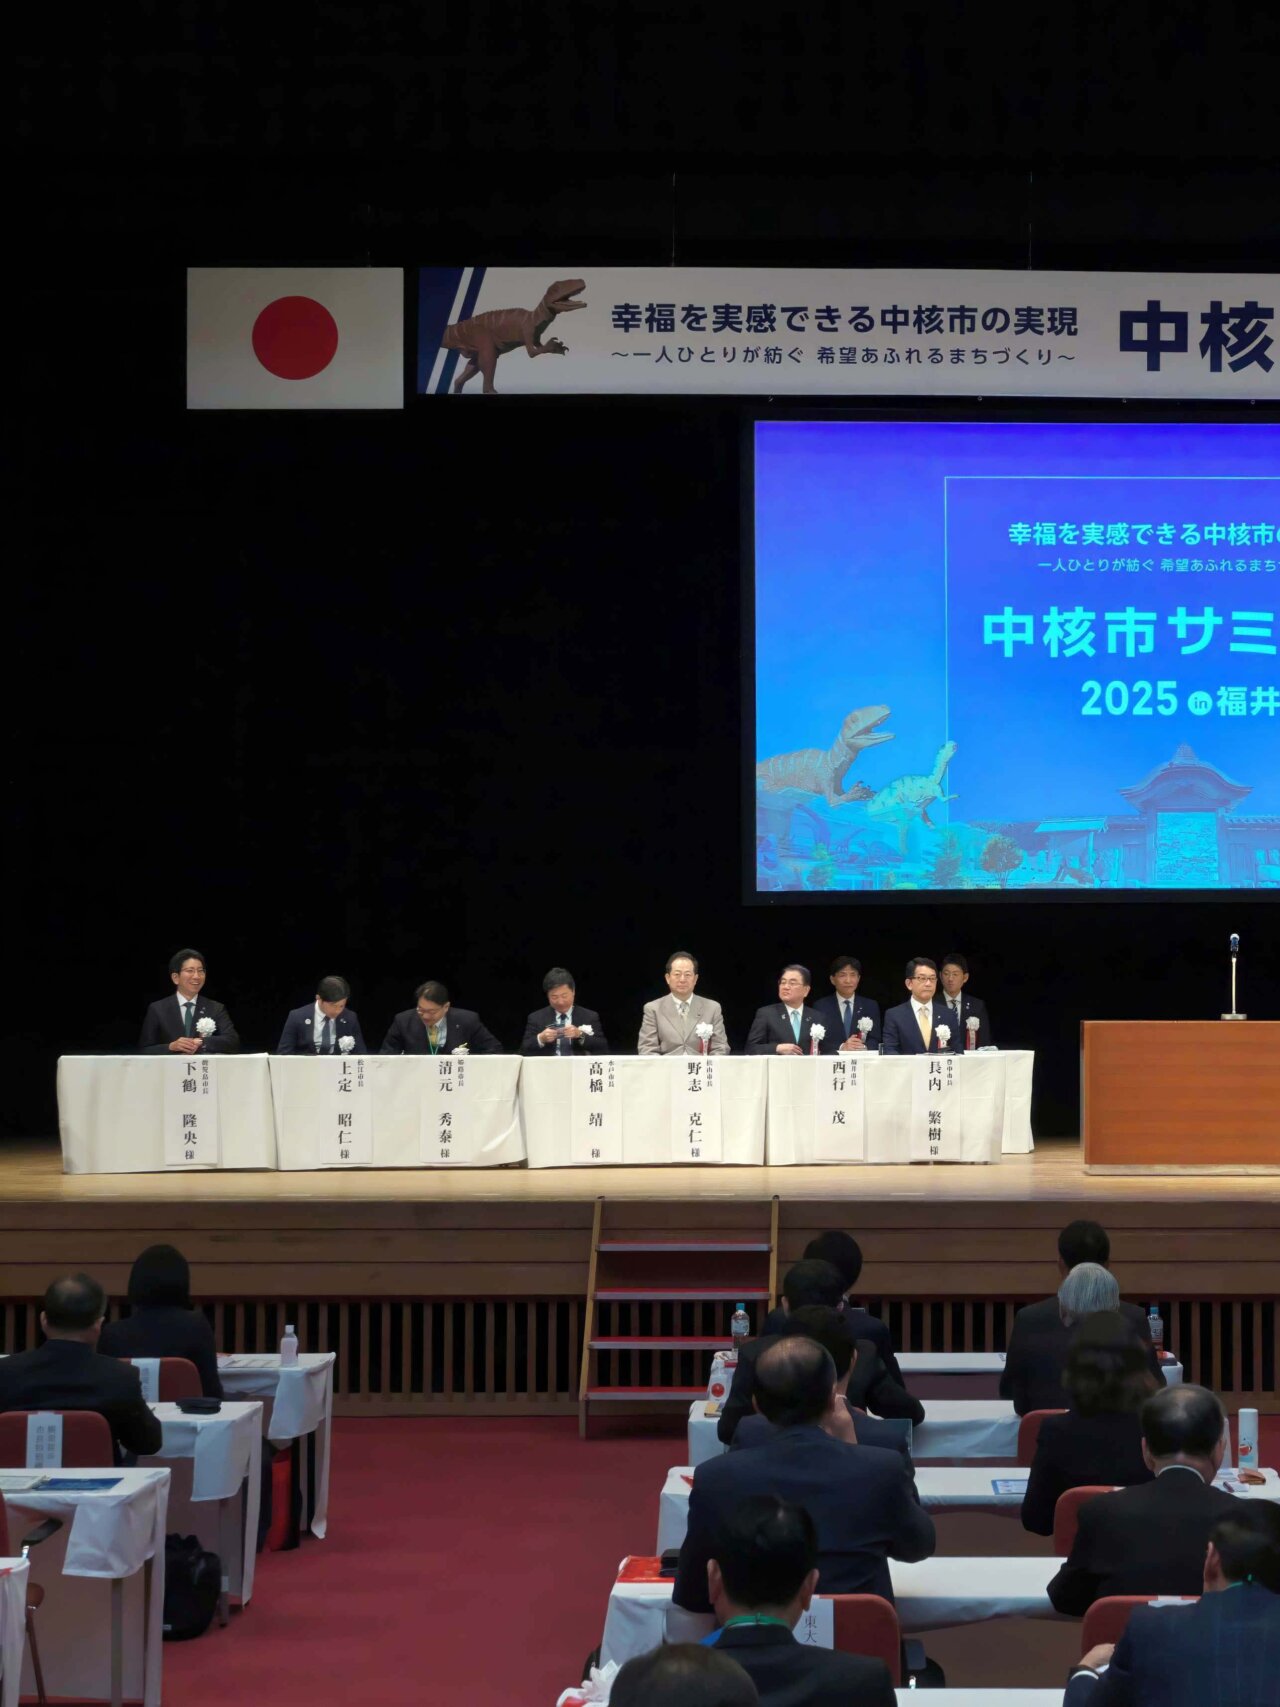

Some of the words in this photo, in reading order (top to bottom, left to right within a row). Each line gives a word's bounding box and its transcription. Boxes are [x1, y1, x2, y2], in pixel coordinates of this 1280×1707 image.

[612, 303, 1078, 336] 幸福を実感できる中核市の実現
[612, 346, 803, 364] ～一人ひとりが紡ぐ
[817, 347, 1075, 365] 希望あふれるまちづくり～
[1038, 558, 1153, 572] 一人ひとりが紡ぐ
[1080, 680, 1178, 716] 2025
[181, 1061, 198, 1093] 下鶴
[337, 1061, 353, 1093] 上定
[438, 1060, 453, 1092] 清元
[687, 1061, 702, 1092] 野志
[832, 1060, 846, 1092] 西行
[928, 1061, 942, 1092] 長内
[832, 1110, 846, 1125] 茂
